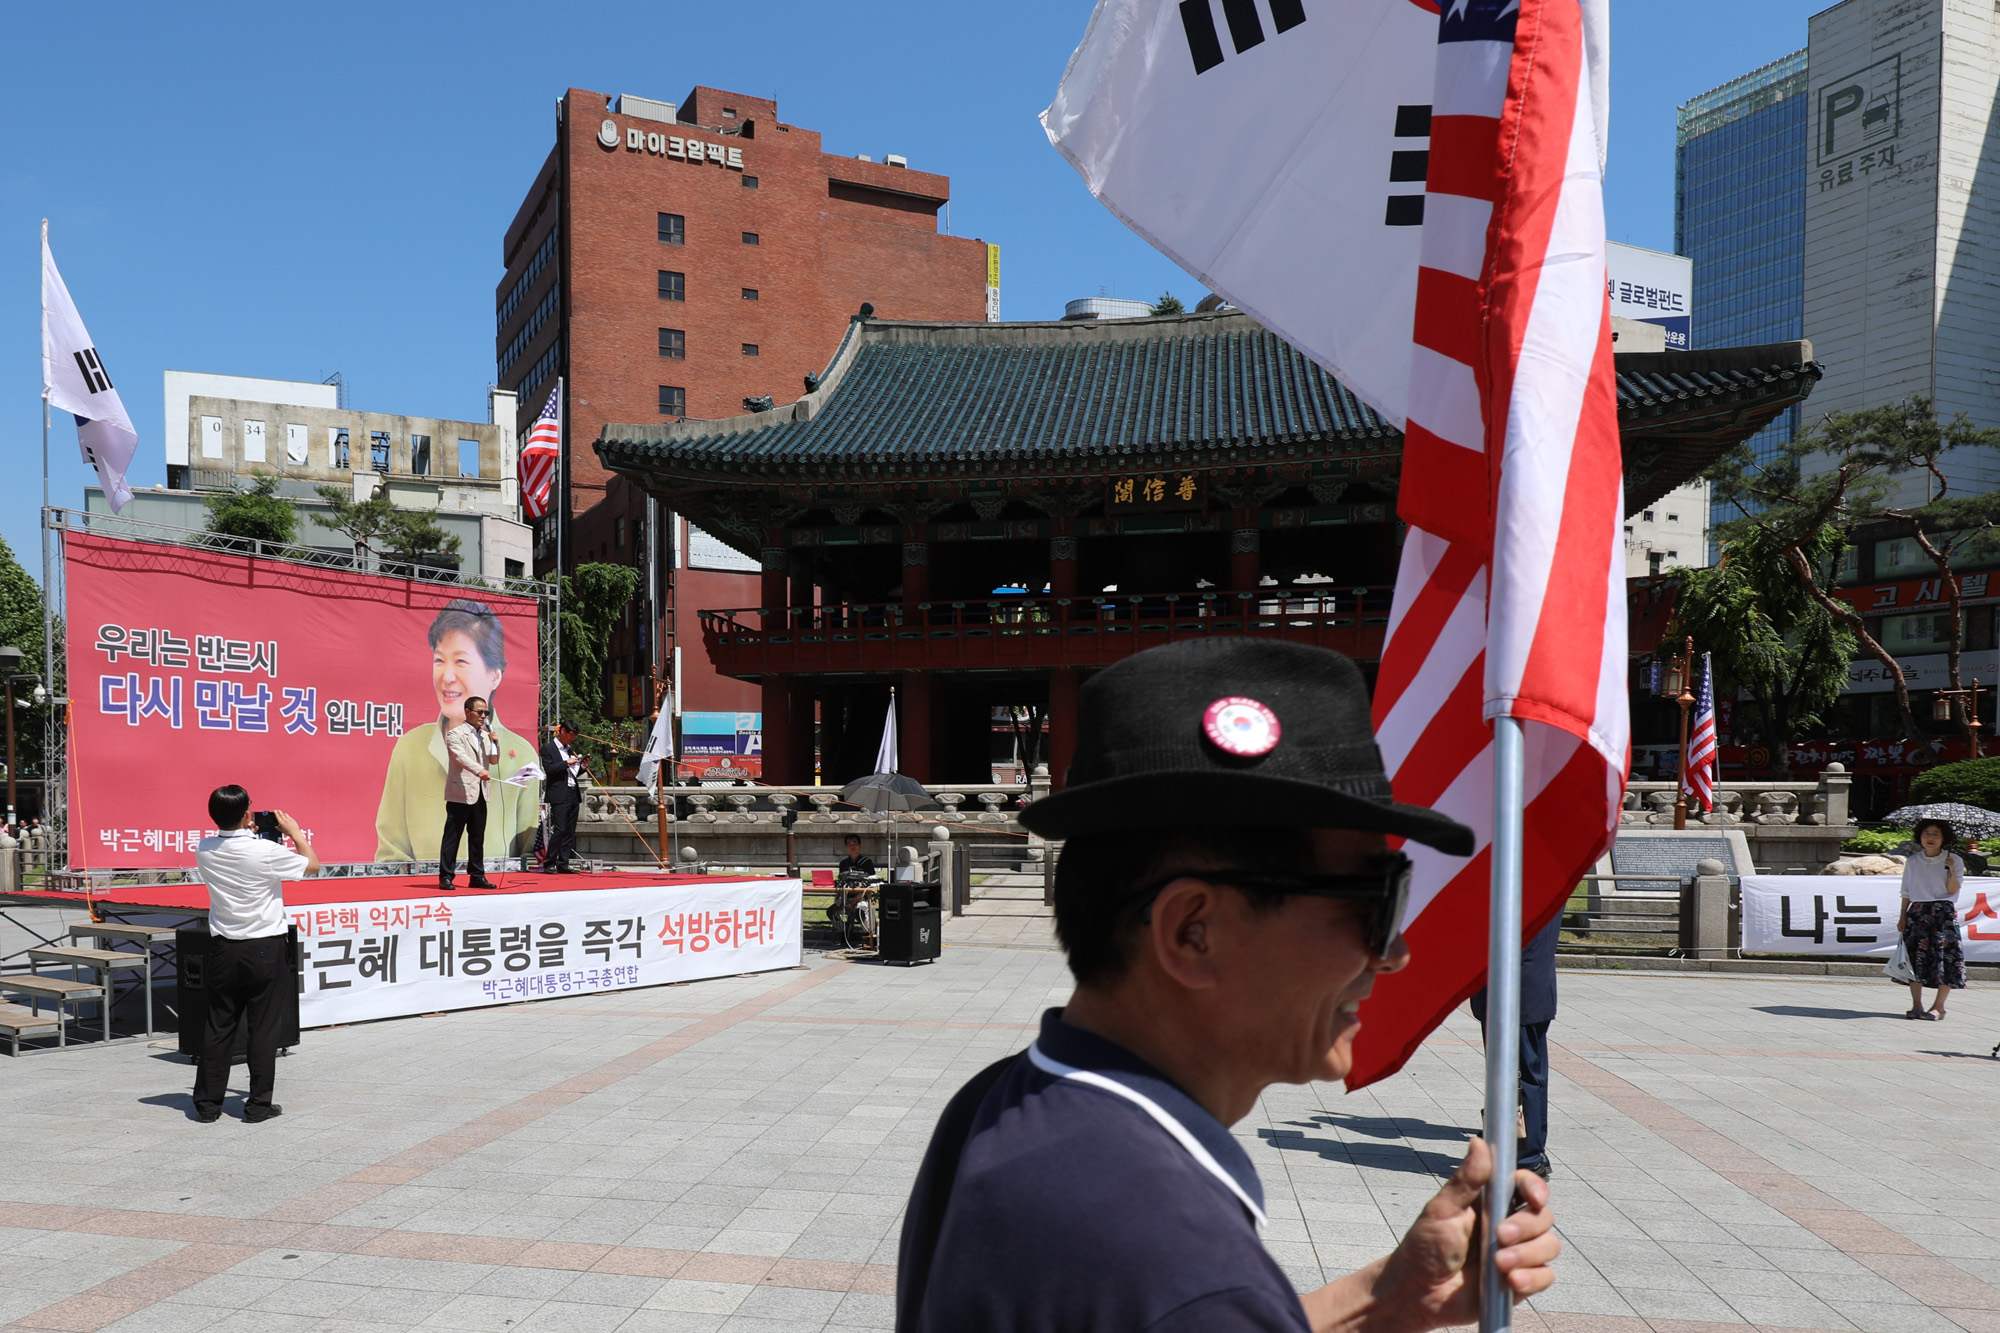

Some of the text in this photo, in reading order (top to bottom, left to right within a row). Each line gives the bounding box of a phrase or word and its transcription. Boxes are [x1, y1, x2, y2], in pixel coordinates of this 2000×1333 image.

[1825, 84, 1864, 156] P
[626, 127, 745, 169] 마이크임팩트
[1819, 161, 1853, 192] 유료
[1619, 281, 1684, 312] 글로벌펀드
[95, 624, 278, 678] 우리는 반드시
[100, 672, 404, 737] 다시 만날 것 입니다!
[704, 767, 748, 777] DURGA
[369, 902, 453, 930] 억지구속
[1781, 895, 1881, 944] 나는
[420, 921, 568, 977] 대통령을
[582, 916, 646, 961] 즉각
[657, 907, 776, 954] 석방하라!
[482, 965, 640, 1000] 박근혜대통령구국총연합
